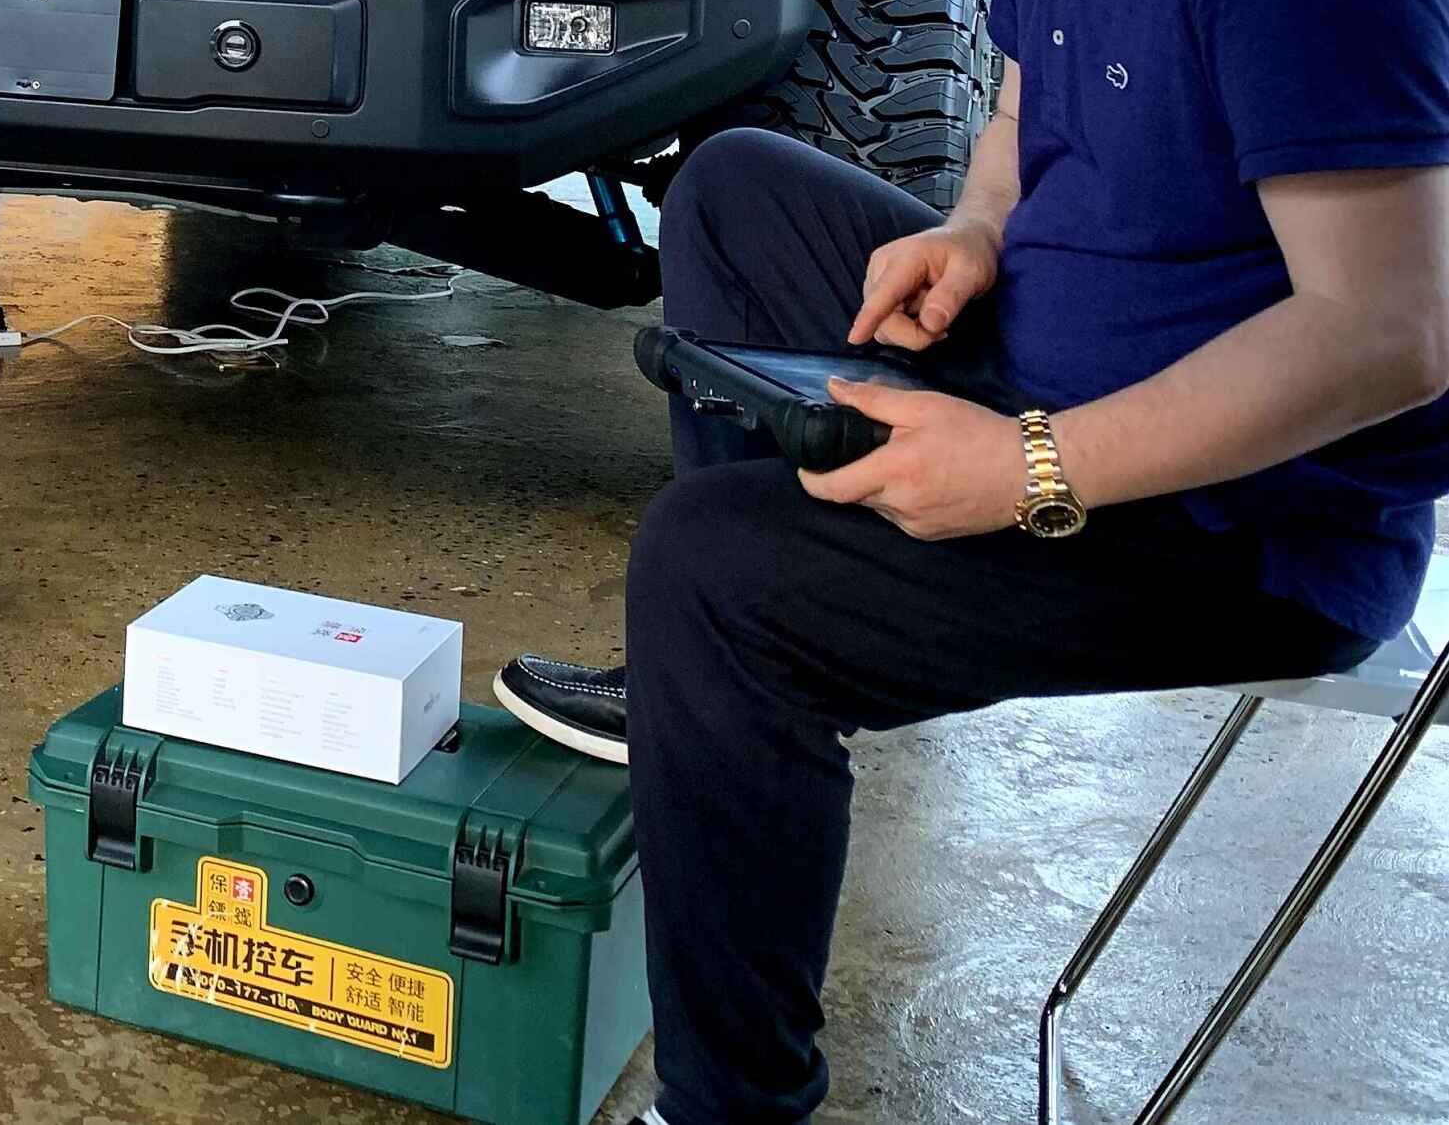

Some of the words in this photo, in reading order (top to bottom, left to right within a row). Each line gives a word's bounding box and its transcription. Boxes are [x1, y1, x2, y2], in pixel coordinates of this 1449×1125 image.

[170, 920, 314, 987] 手机控车
[346, 962, 383, 988] 安全
[389, 972, 425, 1000] 便捷
[311, 1005, 345, 1024] BODY
[347, 1014, 388, 1036] GUARD
[345, 985, 382, 1012] 舒适
[388, 995, 424, 1023] 智能
